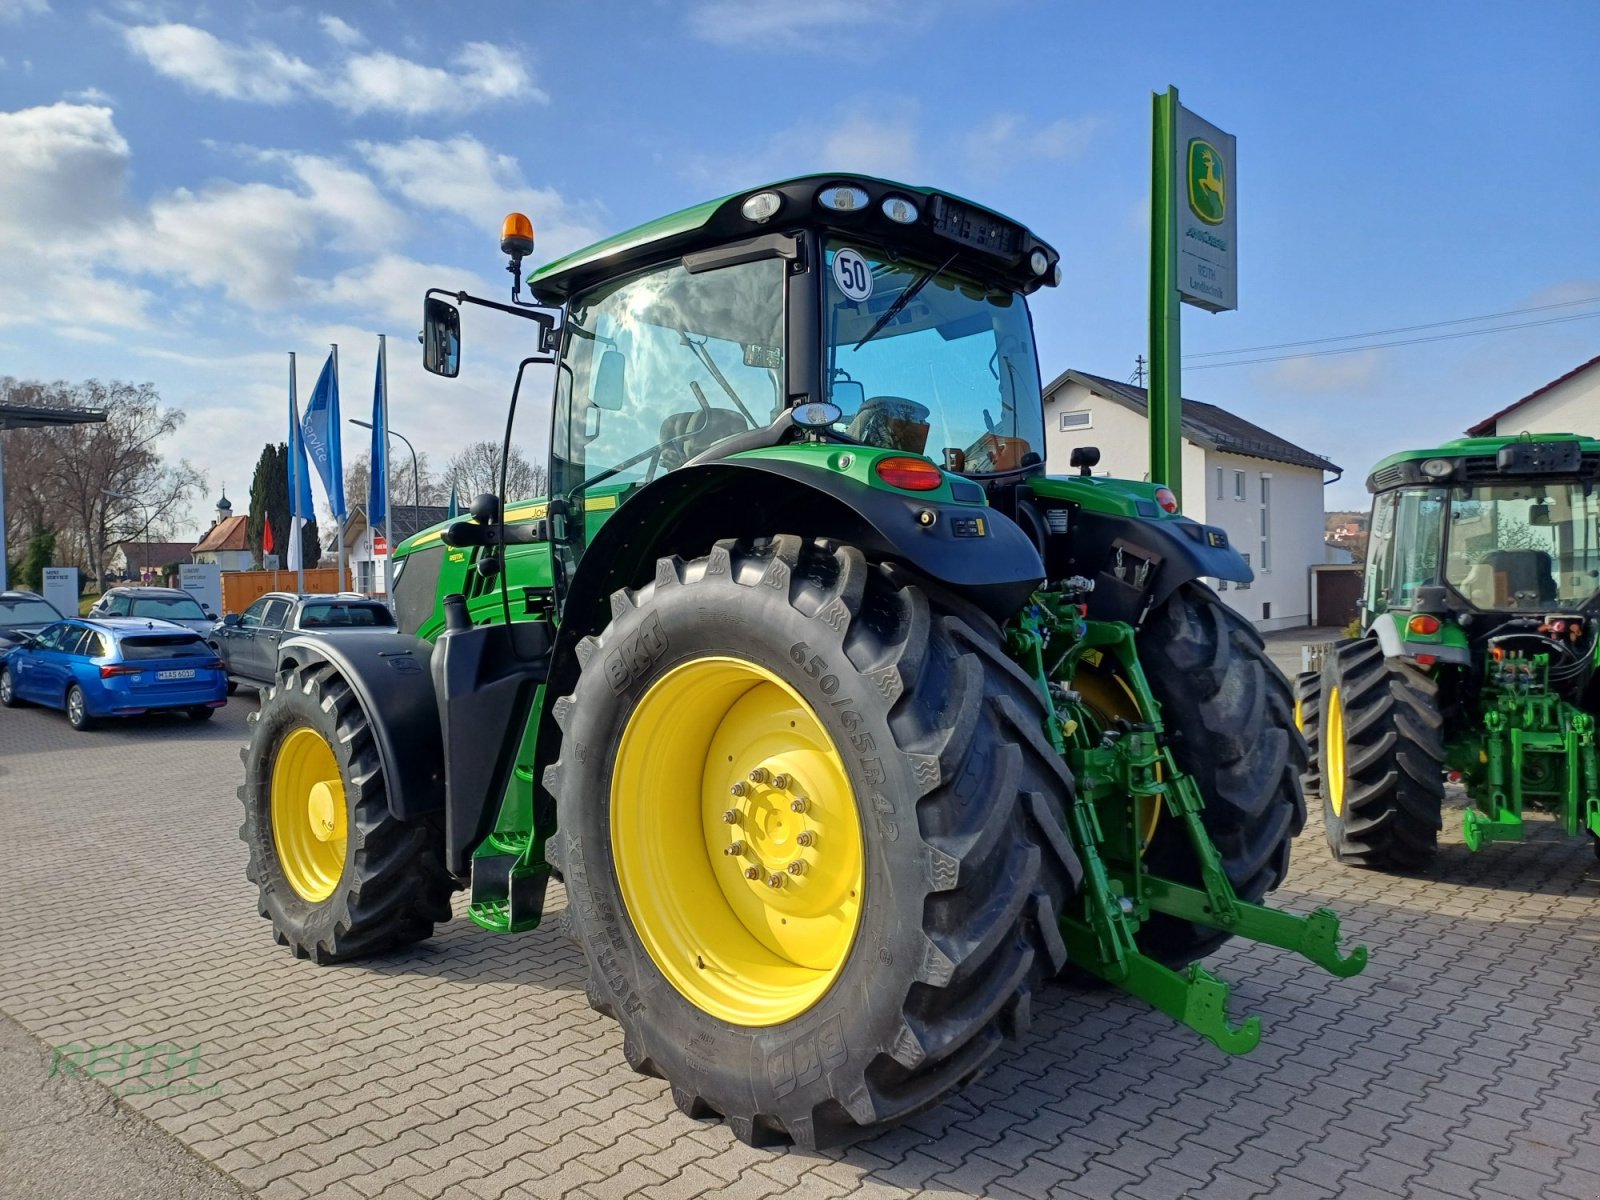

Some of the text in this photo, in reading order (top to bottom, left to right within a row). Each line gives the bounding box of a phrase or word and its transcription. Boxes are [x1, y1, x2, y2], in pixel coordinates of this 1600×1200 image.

[840, 257, 867, 292] 50
[302, 415, 328, 463] Service
[531, 507, 549, 518] JOH
[604, 609, 669, 698] BKT
